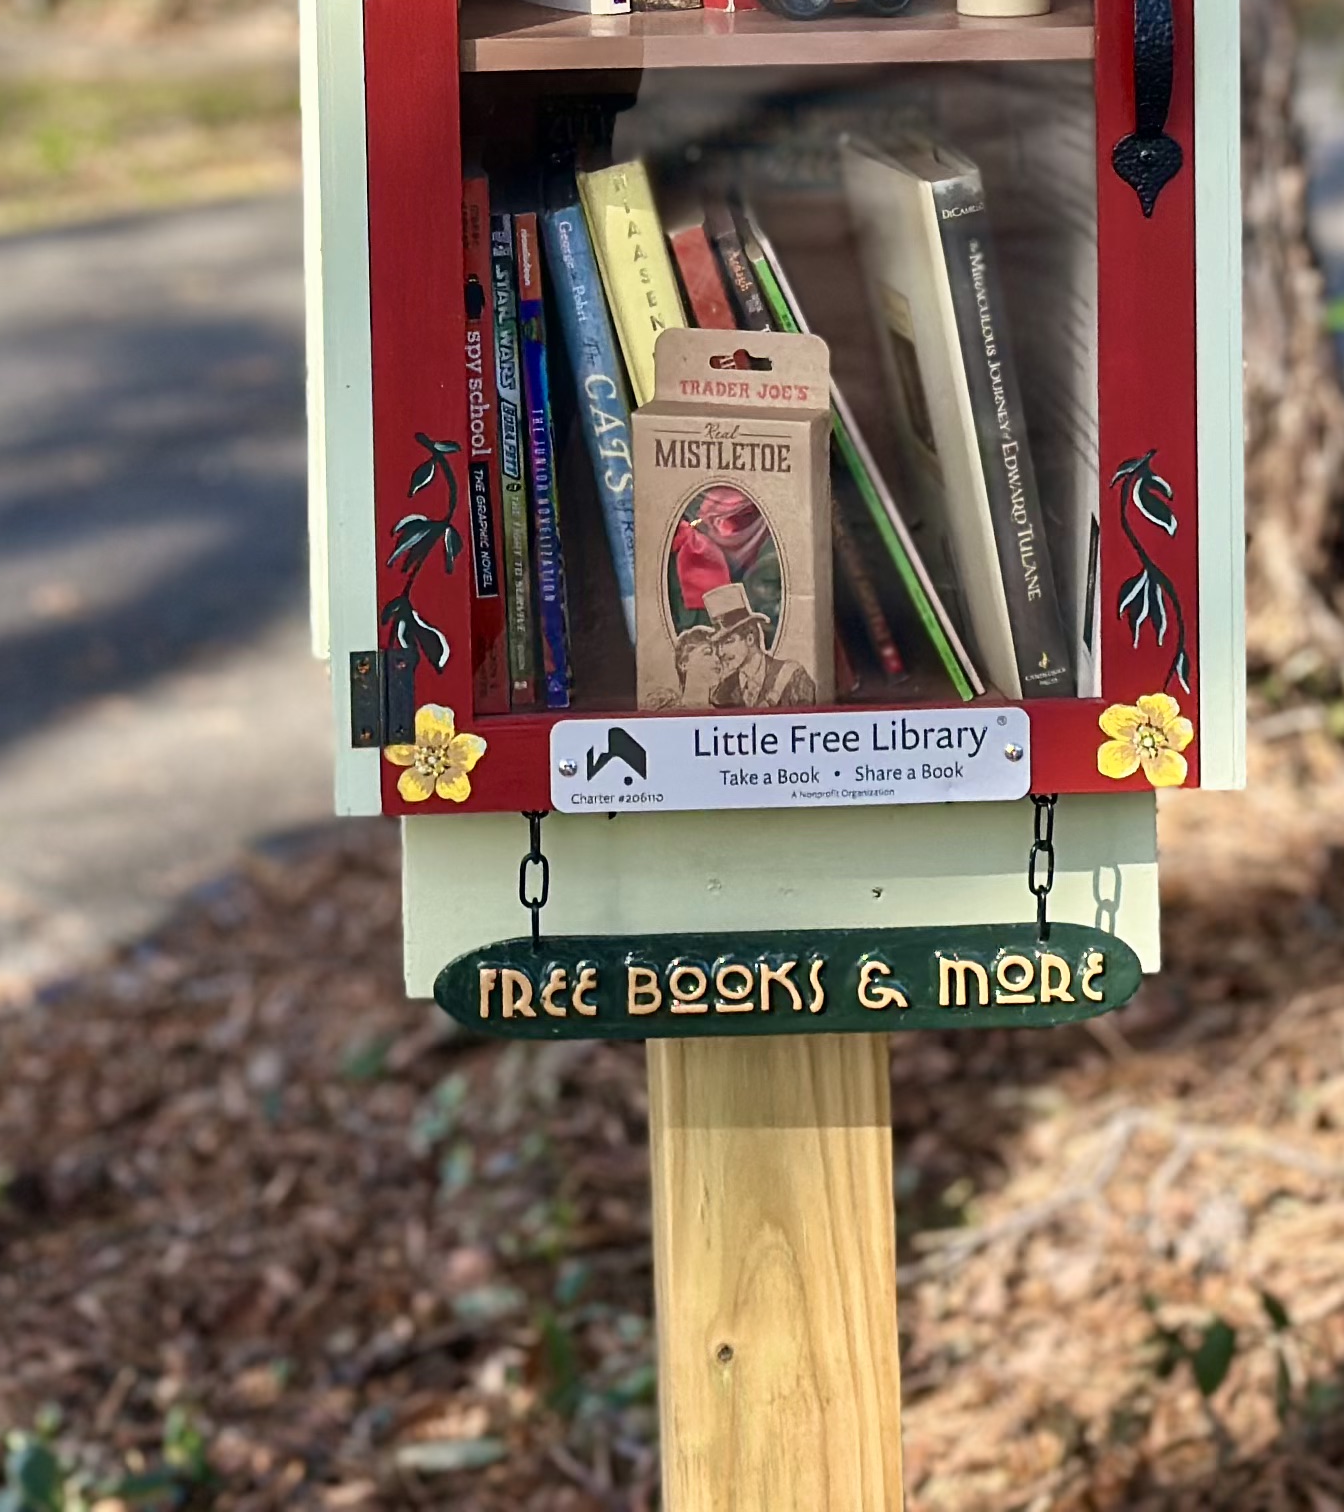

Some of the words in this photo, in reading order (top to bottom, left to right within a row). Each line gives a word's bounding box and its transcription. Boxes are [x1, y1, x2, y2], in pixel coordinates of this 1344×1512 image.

[495, 264, 510, 324] STAR
[465, 331, 482, 372] spy
[499, 326, 516, 391] WARS
[679, 380, 750, 399] TRADER
[757, 384, 810, 402] JOE'S
[468, 377, 492, 457] school
[532, 409, 544, 433] THE
[585, 373, 633, 493] CATS
[704, 422, 741, 439] Real
[969, 253, 997, 356] MIRACULOUS
[987, 360, 1011, 432] JOURNEY
[1001, 441, 1027, 525] EDWARD
[1016, 523, 1042, 602] TULANE
[534, 436, 548, 491] JUNIOR
[655, 438, 791, 473] MISTLETOE
[473, 469, 485, 493] THE
[475, 495, 491, 550] GRAPHIC
[481, 551, 494, 589] NOVEL
[537, 497, 556, 602] NOVELIZATION
[694, 723, 779, 757] Little
[791, 725, 860, 754] Free
[872, 718, 988, 758] Library
[720, 769, 758, 786] Take
[763, 772, 773, 785] a
[778, 766, 820, 784] Book
[855, 764, 902, 782] Share
[907, 768, 917, 780] a
[922, 761, 964, 779] Book
[571, 793, 615, 804] Charter
[479, 967, 597, 1019] FREE
[627, 960, 825, 1016] BOOKS
[857, 960, 908, 1009] &
[939, 953, 1104, 1007] MORE
